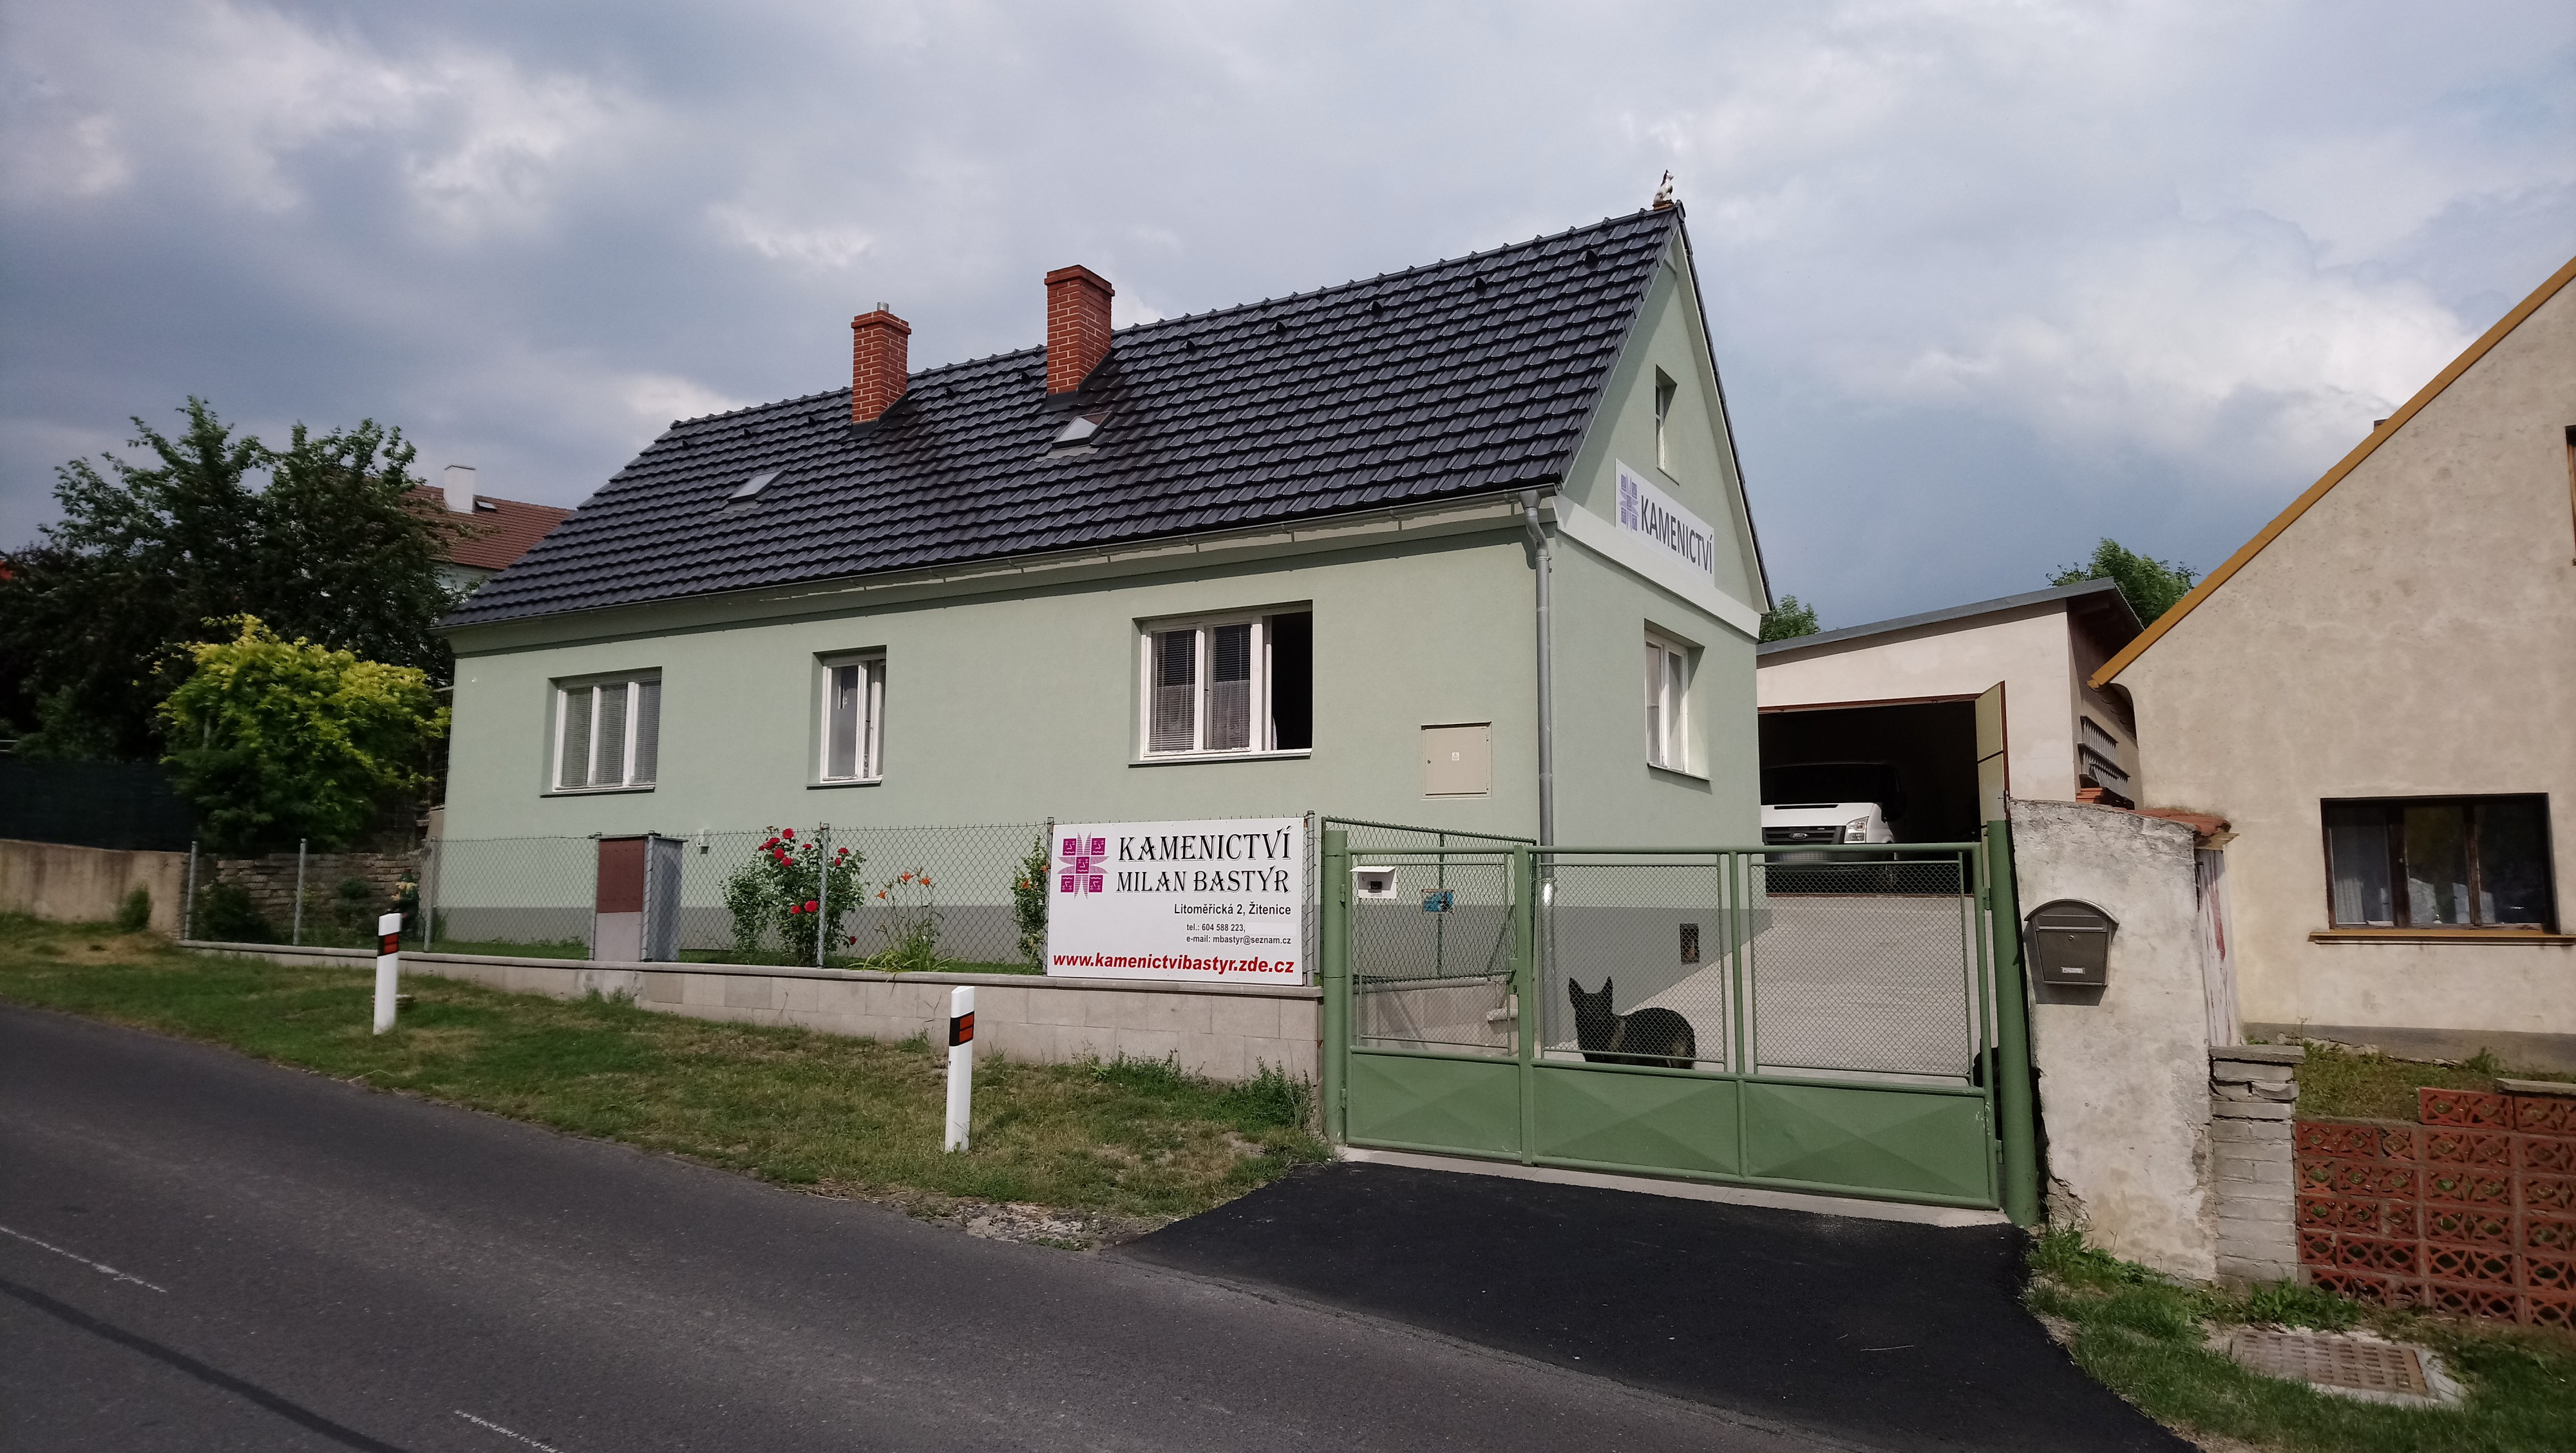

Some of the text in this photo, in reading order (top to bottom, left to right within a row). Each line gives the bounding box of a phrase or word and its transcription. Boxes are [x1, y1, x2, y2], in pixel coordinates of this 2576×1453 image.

[1641, 495, 1713, 575] KAMENICTVÍ
[1117, 825, 1293, 862] KAMENICTVÍ
[1115, 871, 1187, 893] MILAN
[1174, 901, 1291, 916] Litoměřická 2, Žitenice
[1186, 923, 1245, 933] tel.: 604 588 223,
[1186, 935, 1291, 945] e-mail: mbastyr@seznam.cz
[1053, 952, 1295, 974] www.kamenictvibastyr.zde.cz
